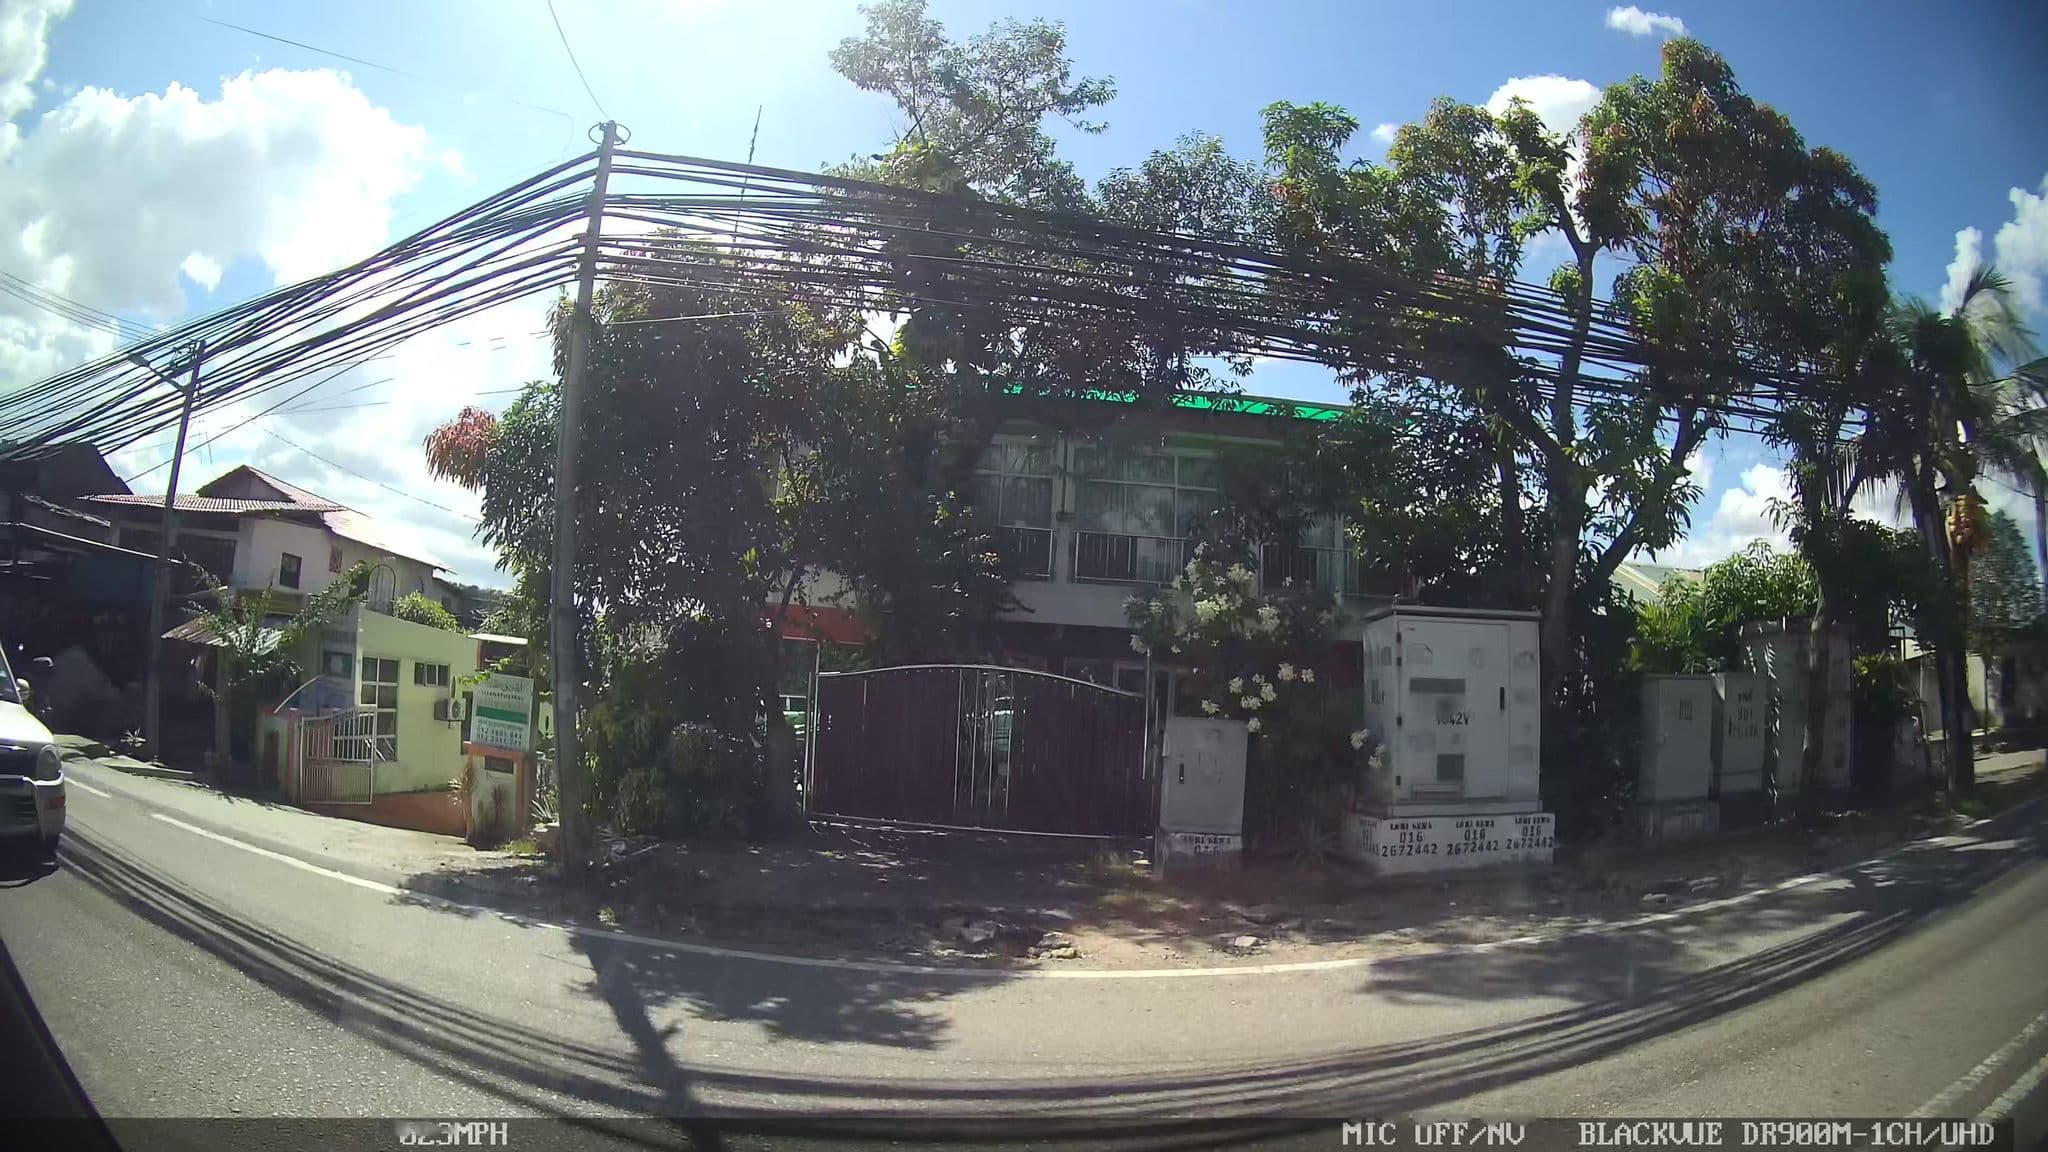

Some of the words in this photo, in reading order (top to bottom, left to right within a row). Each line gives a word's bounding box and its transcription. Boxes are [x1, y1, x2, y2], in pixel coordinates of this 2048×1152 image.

[1400, 831, 1424, 843] 016
[1464, 828, 1486, 841] 016
[1382, 843, 1438, 858] 2672442
[1446, 839, 1499, 856] 2672442
